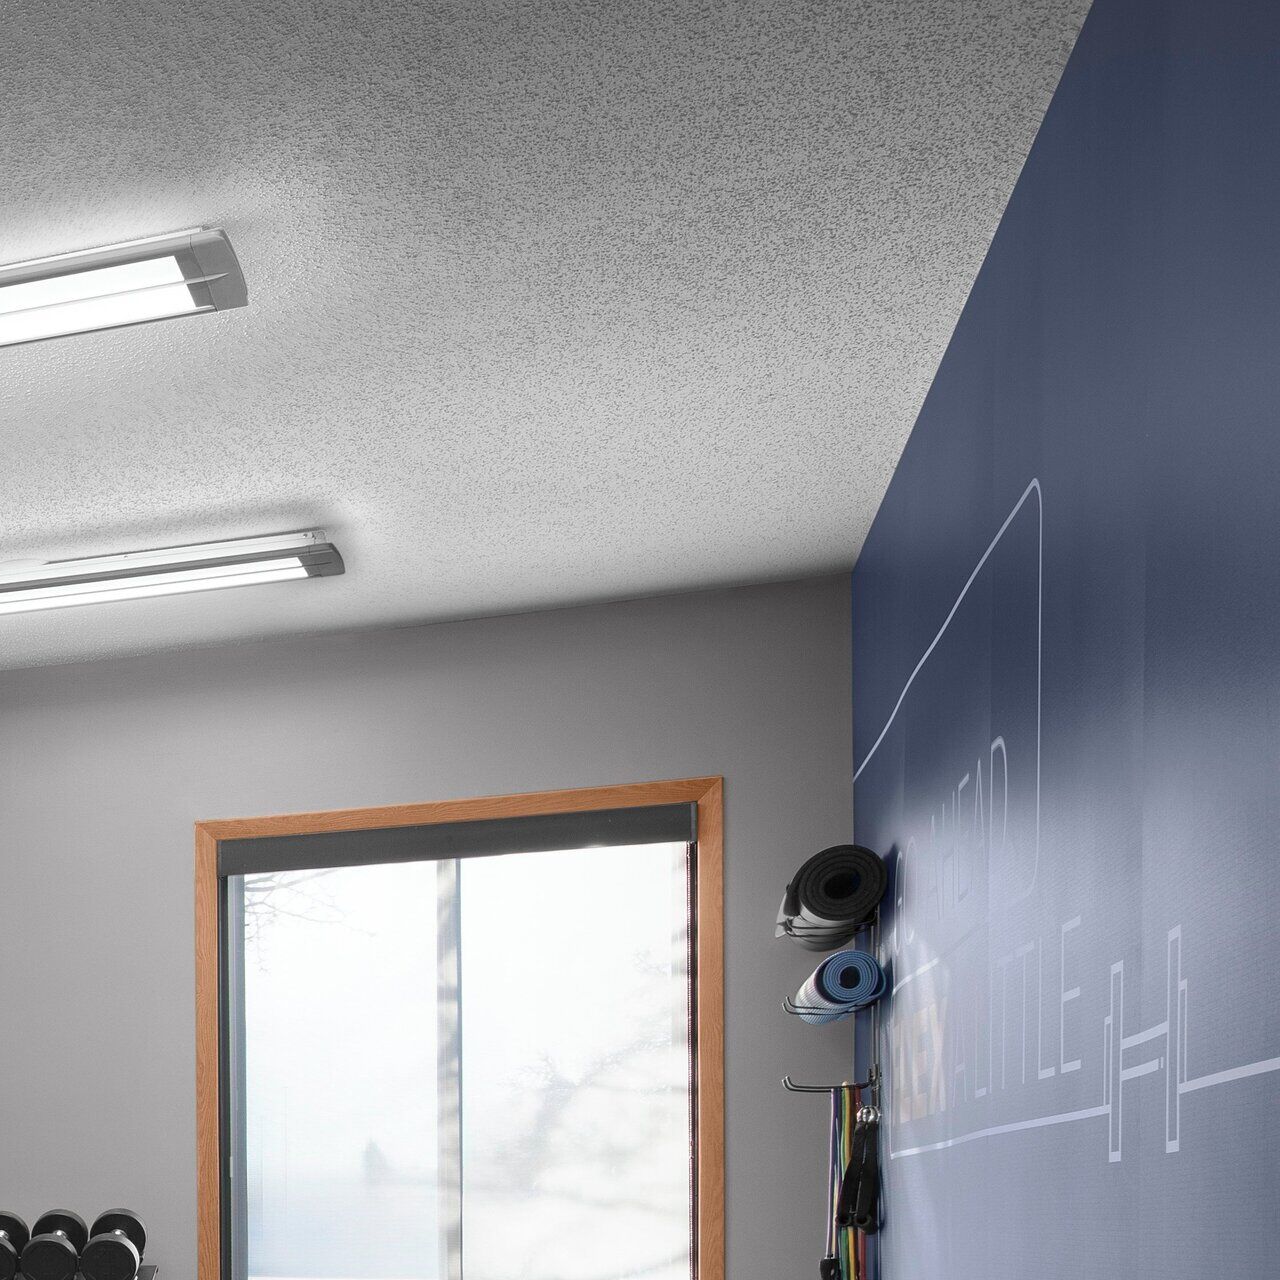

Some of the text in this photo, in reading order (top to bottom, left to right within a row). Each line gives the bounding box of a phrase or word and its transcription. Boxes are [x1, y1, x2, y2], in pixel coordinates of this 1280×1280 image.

[894, 735, 1008, 954] GO AHEAD
[974, 915, 1082, 1098] LITTLE
